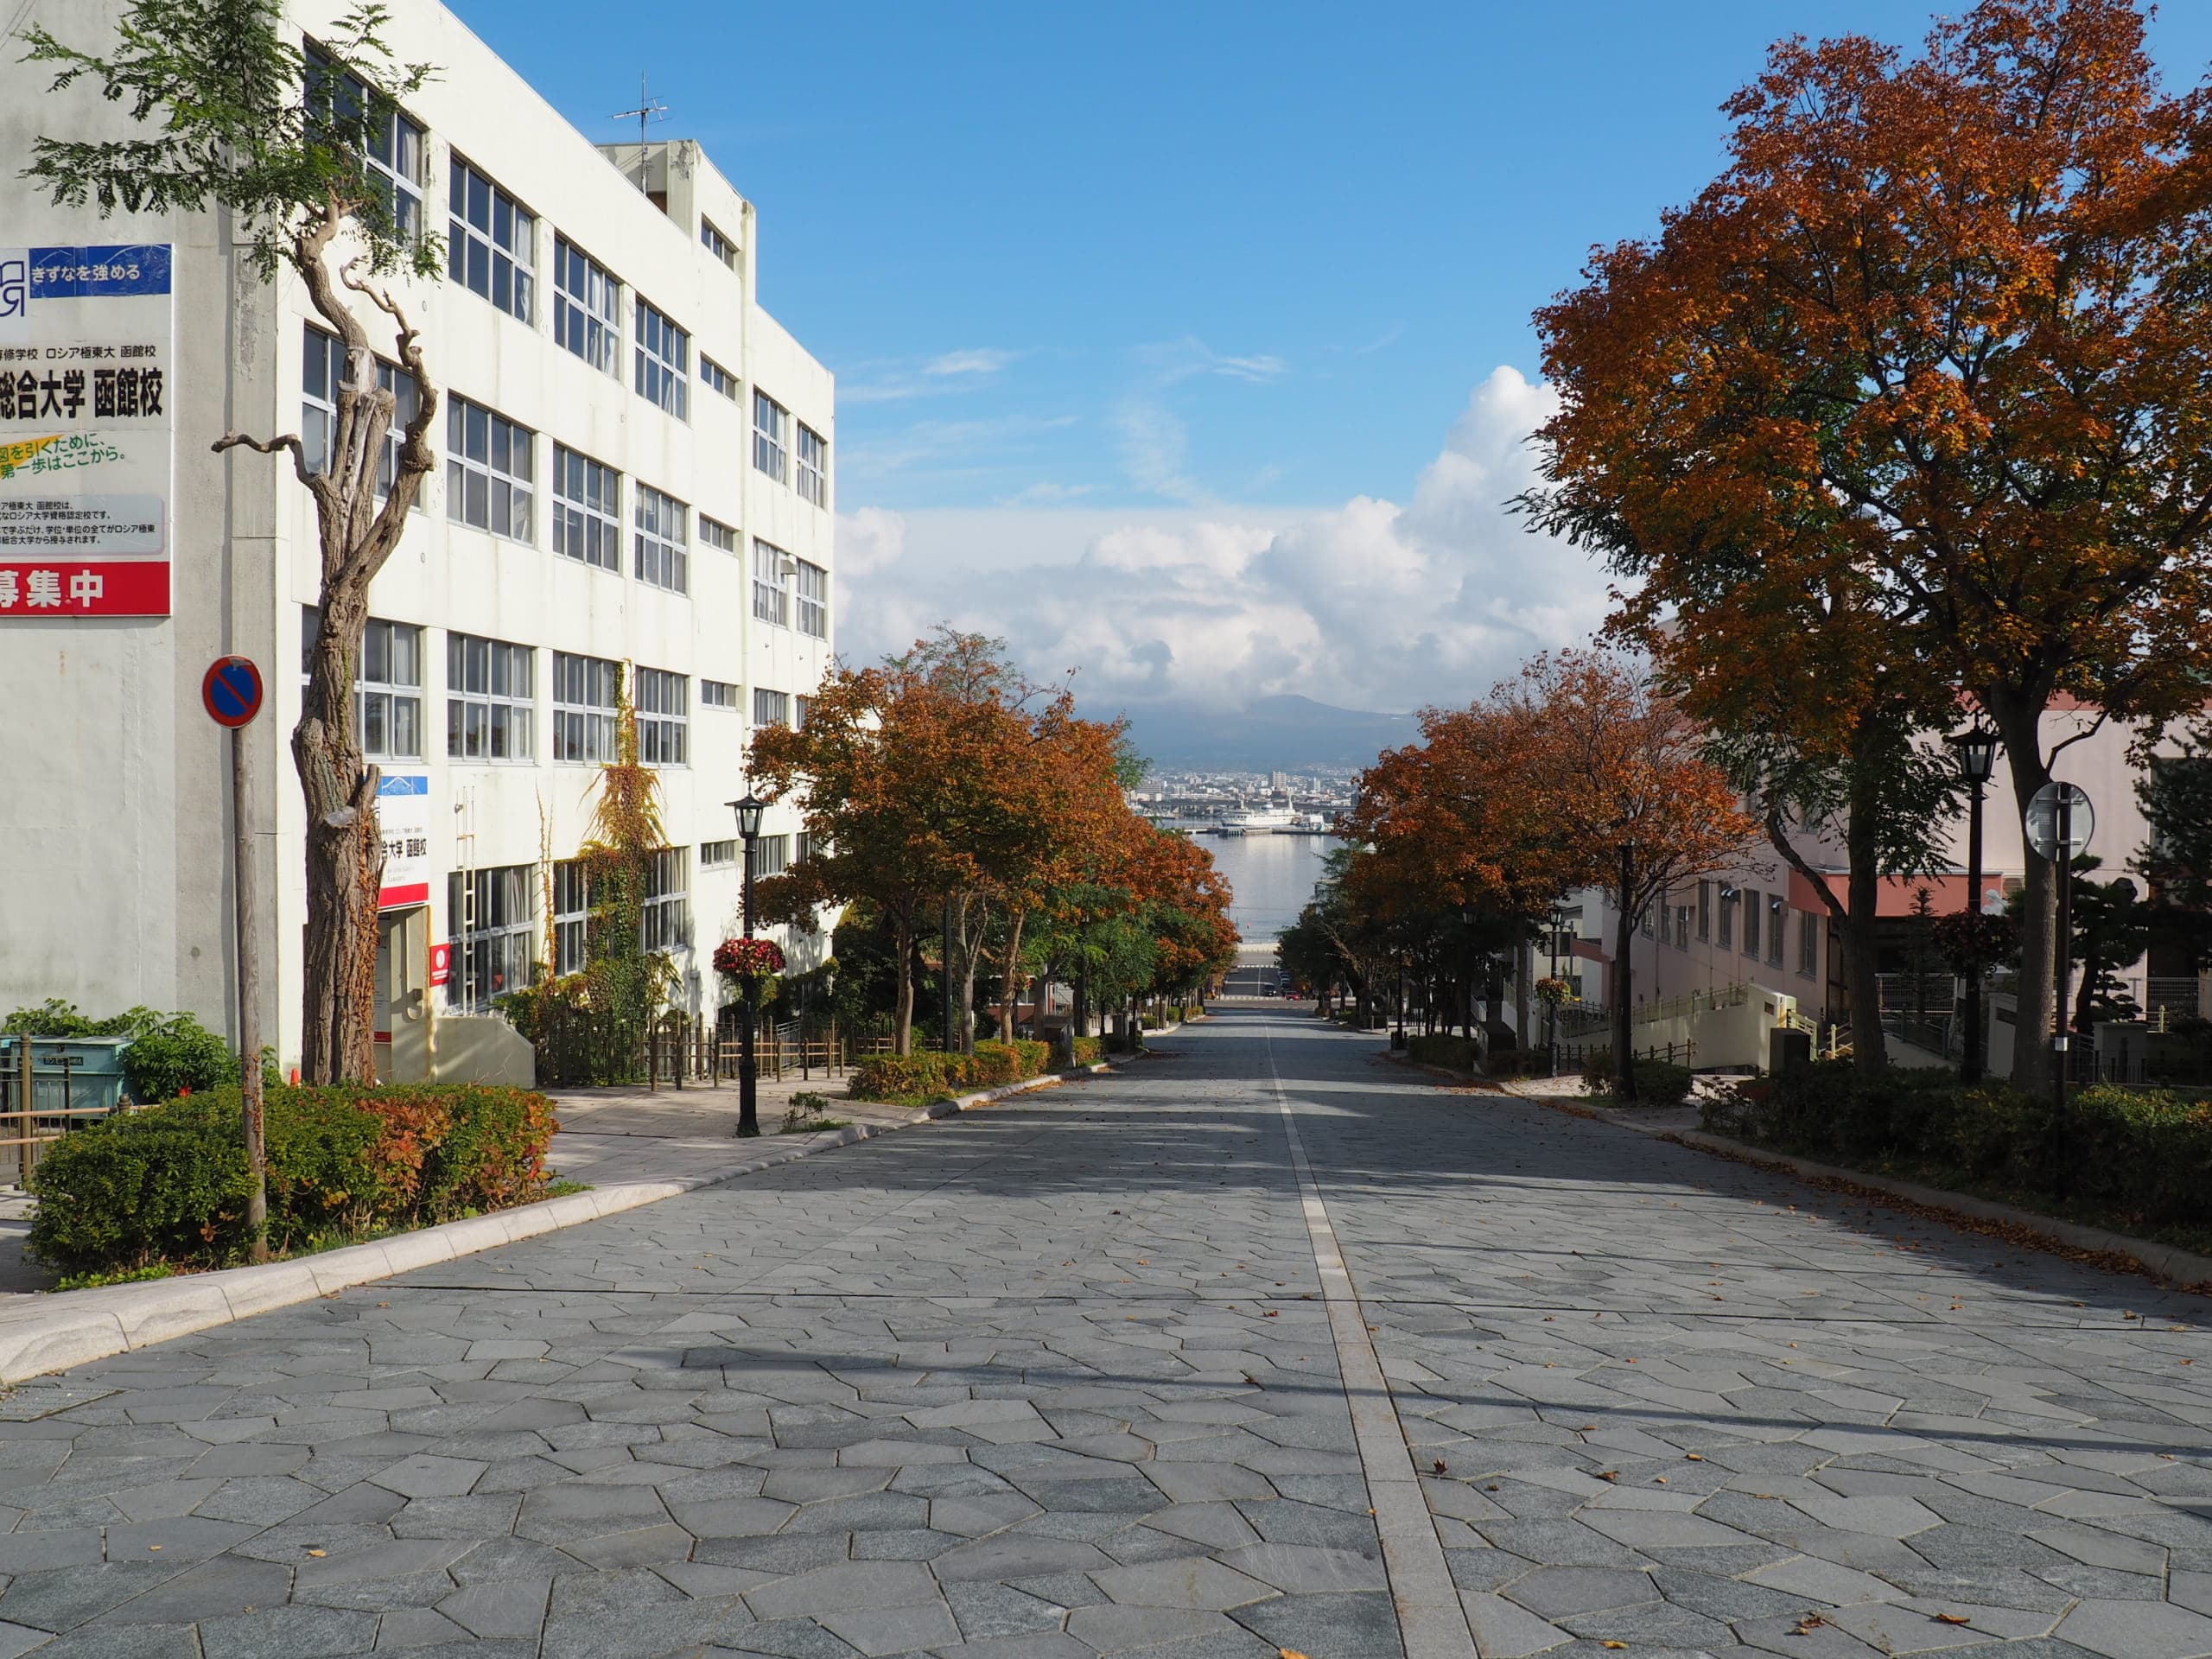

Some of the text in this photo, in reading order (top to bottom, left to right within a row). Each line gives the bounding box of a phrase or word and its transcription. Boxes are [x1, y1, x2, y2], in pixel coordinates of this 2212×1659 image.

[31, 264, 140, 283] きずなを強める
[46, 346, 116, 359] ロシア極東大
[120, 346, 156, 358] 函館校
[94, 367, 162, 418] 函館校
[0, 511, 111, 520] なロシア大学資格認定校です。
[0, 536, 100, 545] 総合大学から授与されます。
[0, 569, 104, 608] 募集中
